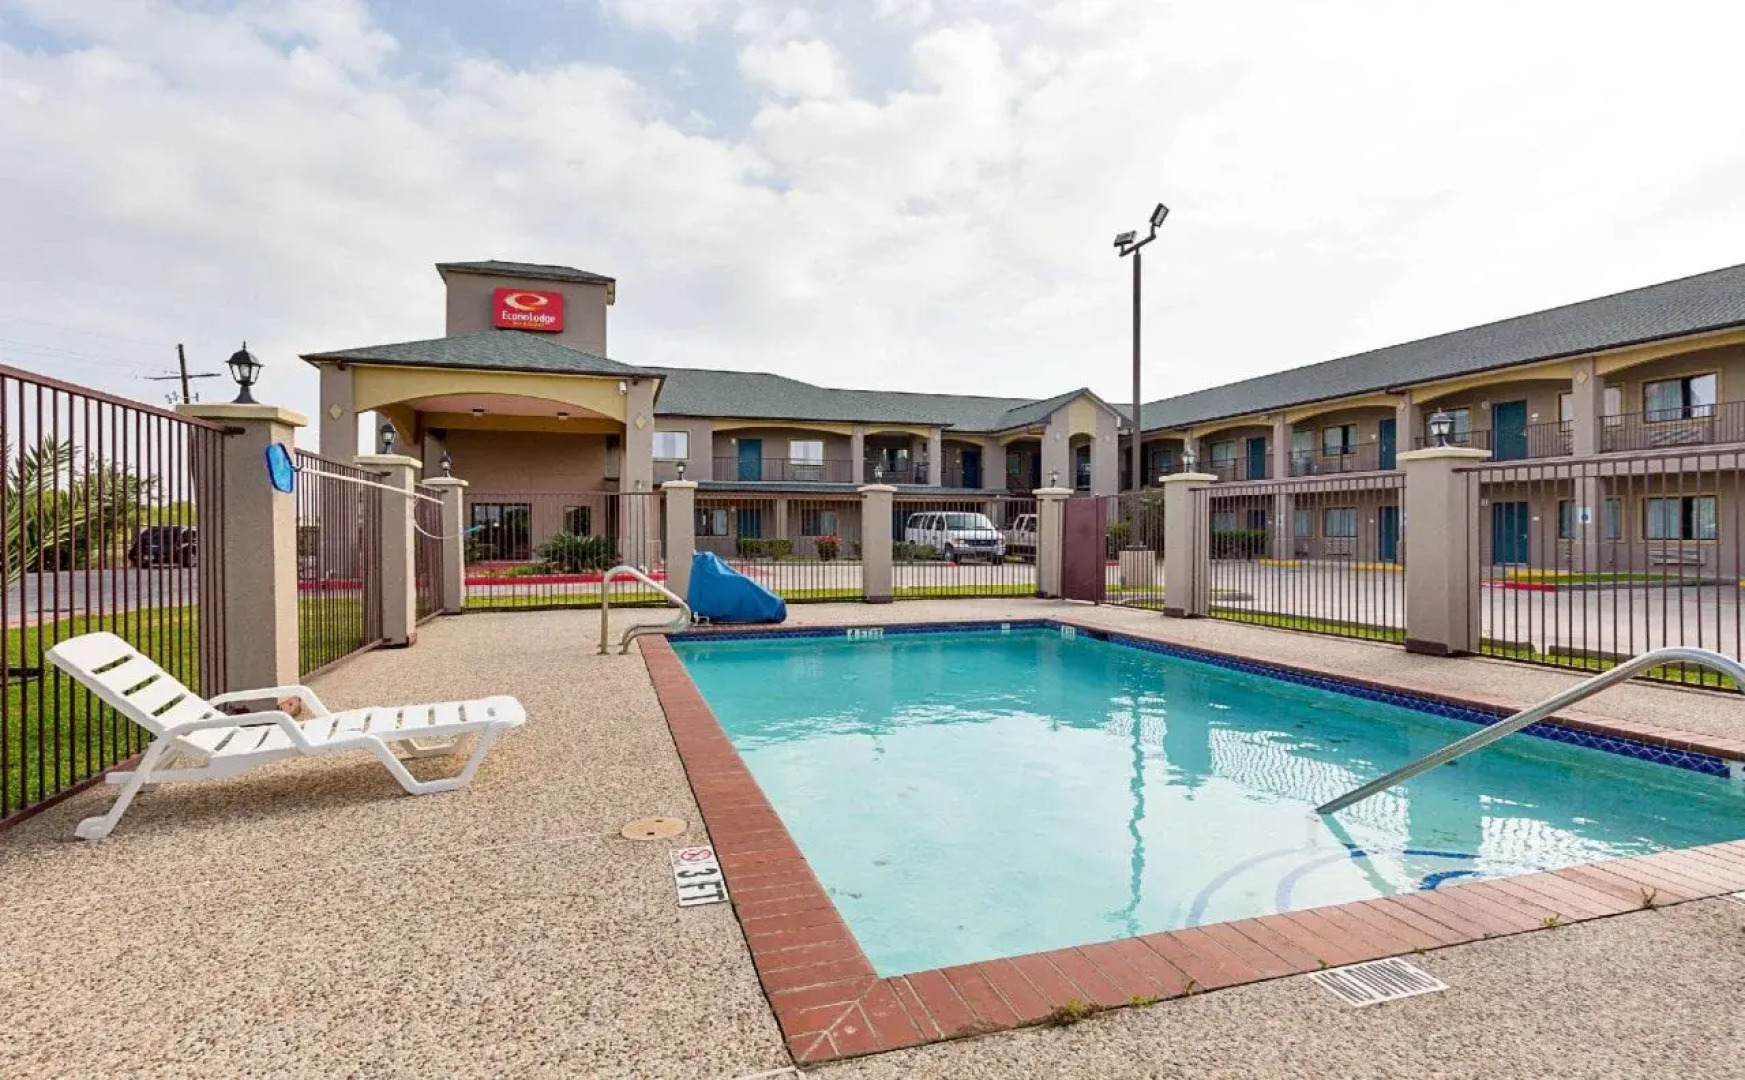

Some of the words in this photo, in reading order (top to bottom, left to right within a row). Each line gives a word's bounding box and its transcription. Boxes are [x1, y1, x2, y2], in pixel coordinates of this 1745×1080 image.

[677, 868, 717, 878] 3
[679, 881, 725, 901] FT
[1313, 971, 1375, 1004] NO
[1343, 959, 1439, 997] DIVING
